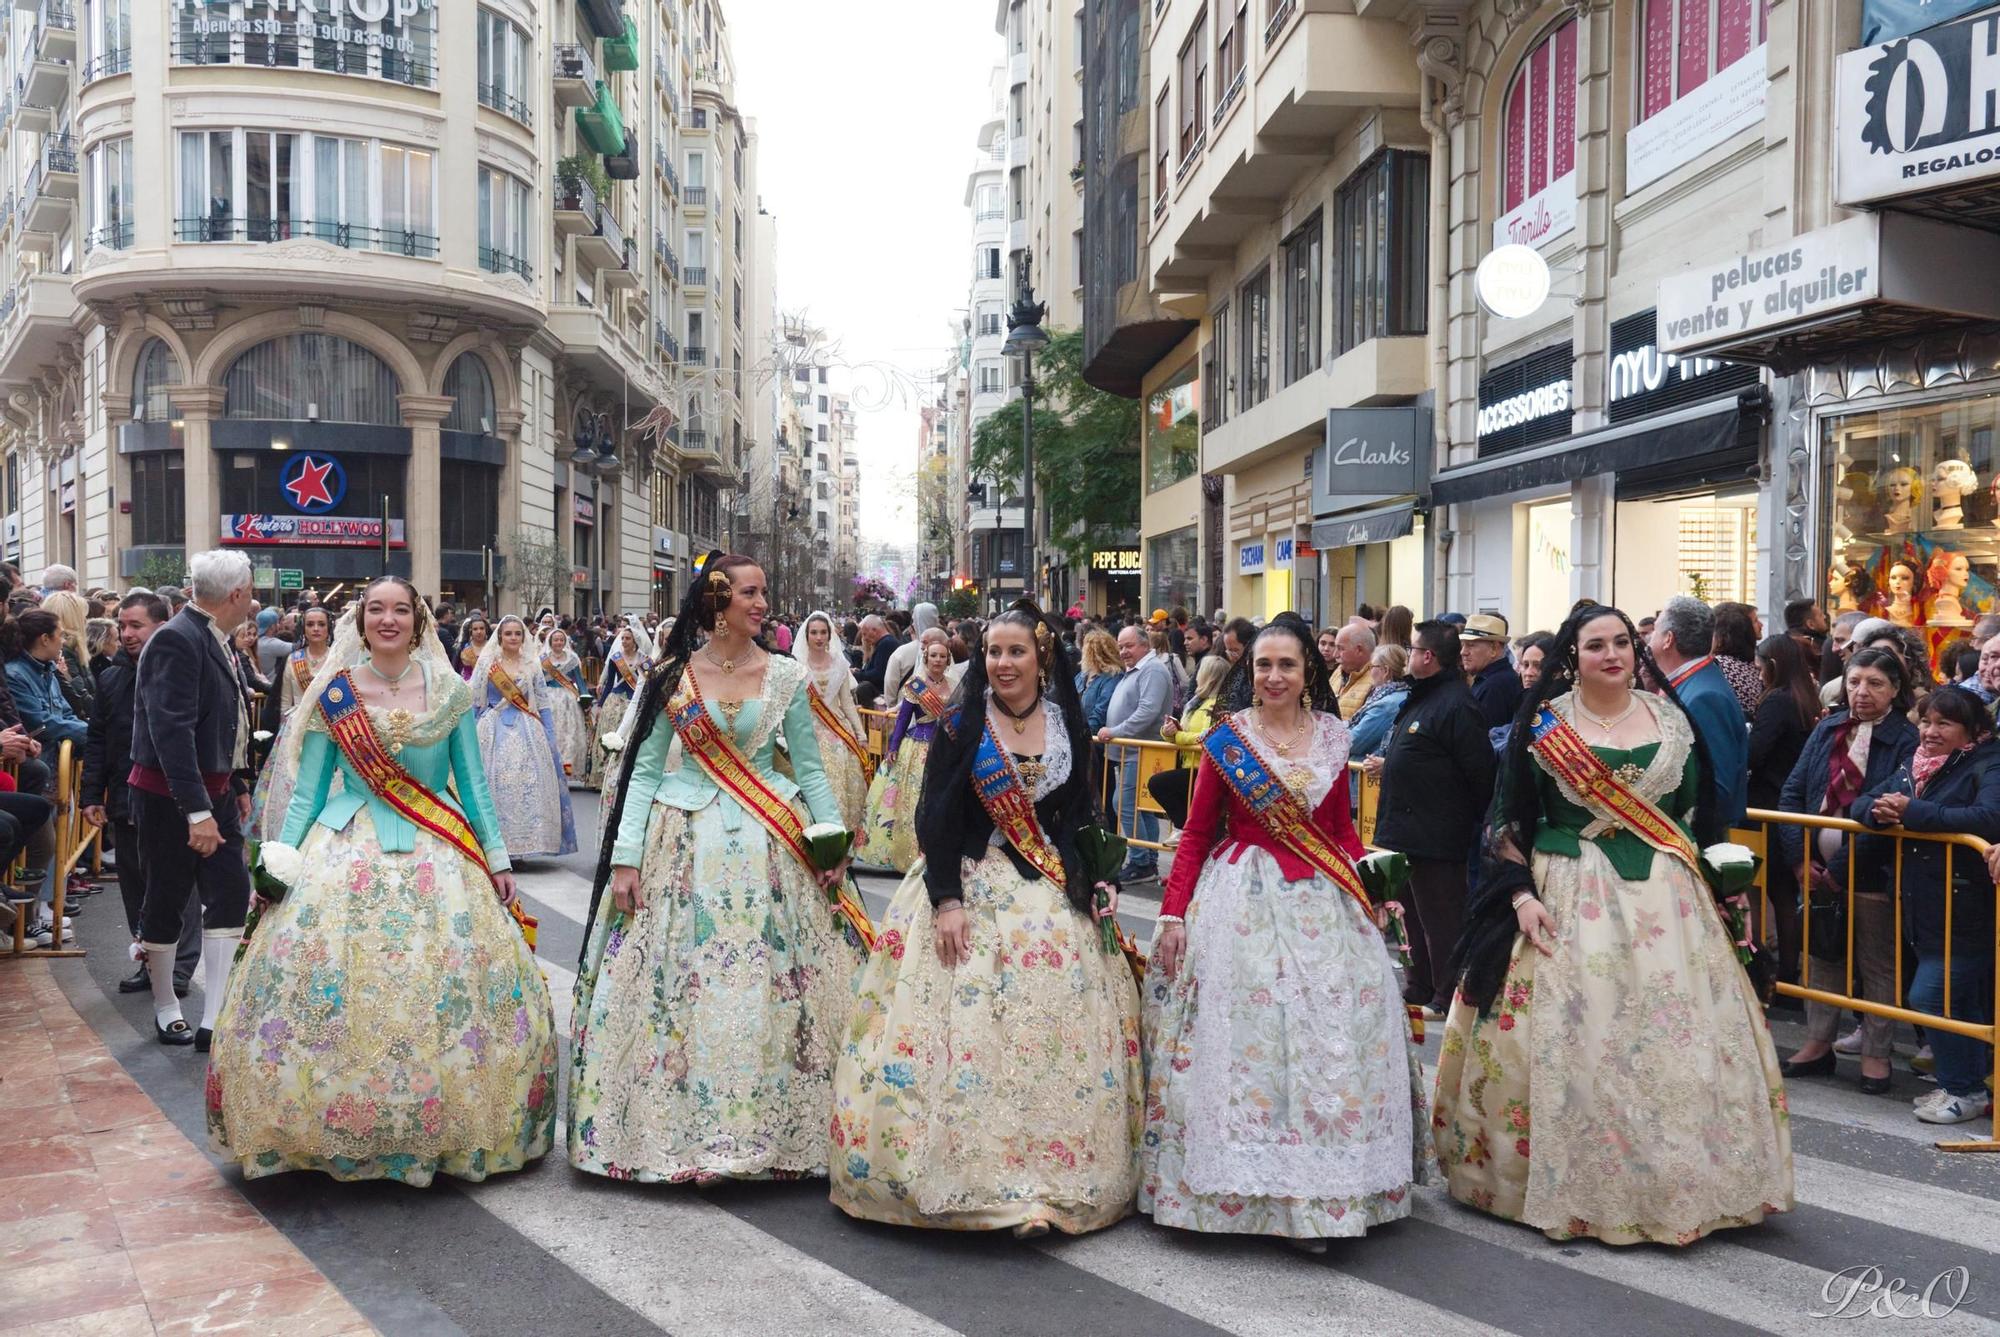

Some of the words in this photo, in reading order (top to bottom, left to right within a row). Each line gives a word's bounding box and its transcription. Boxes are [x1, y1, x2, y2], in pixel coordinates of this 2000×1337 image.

[193, 19, 251, 35] Agencia
[254, 19, 282, 35] SEO
[321, 25, 351, 42] 900
[354, 29, 374, 45] 83
[376, 33, 394, 50] 49
[397, 38, 415, 54] 08
[1712, 248, 1803, 302] pelucas
[1666, 304, 1729, 341] venta
[1738, 299, 1754, 330] y
[1764, 265, 1868, 316] alquiler
[1476, 379, 1570, 438] ACCESSORIES
[1334, 437, 1410, 465] Clarks
[1346, 523, 1369, 543] Clarks
[1093, 551, 1117, 569] PEPE
